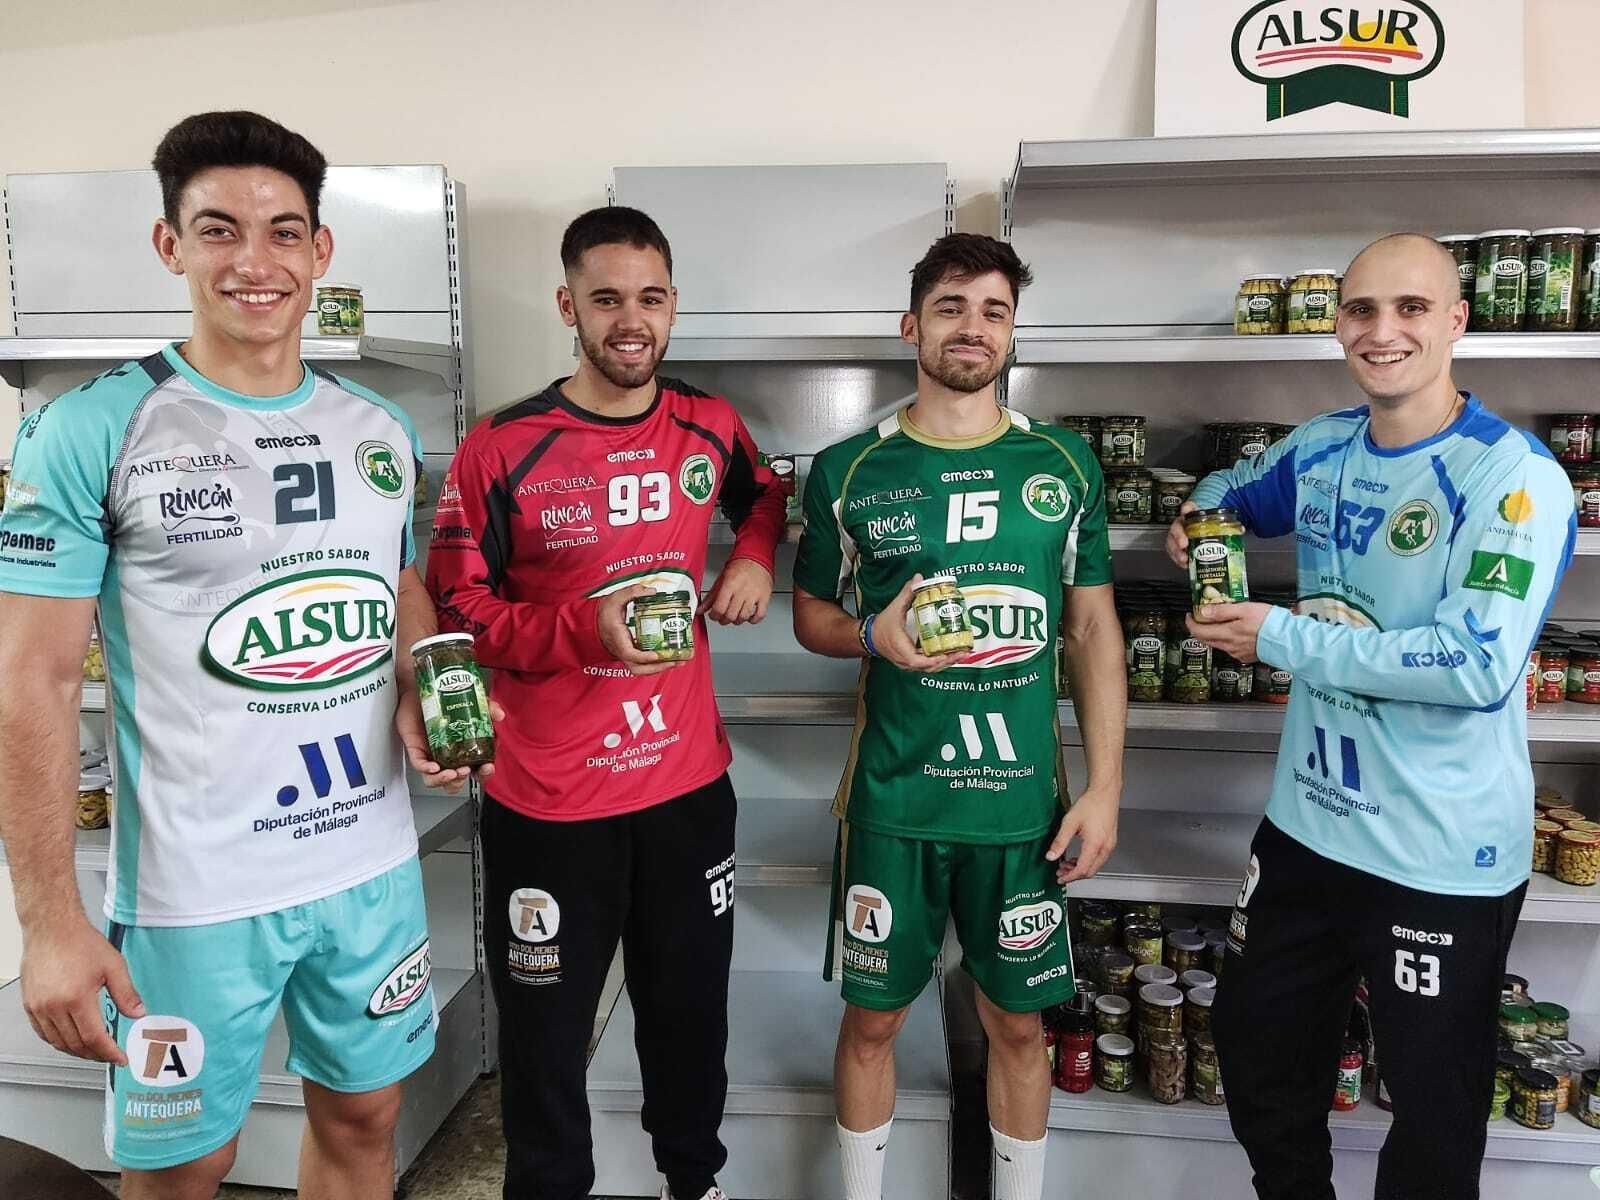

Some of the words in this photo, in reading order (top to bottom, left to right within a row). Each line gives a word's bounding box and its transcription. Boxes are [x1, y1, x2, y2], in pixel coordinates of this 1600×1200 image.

[1257, 7, 1419, 51] ALSUR
[1495, 262, 1522, 271] ALSUR
[255, 435, 309, 449] emec
[607, 450, 647, 463] emec
[941, 469, 982, 482] emec
[273, 460, 336, 525] 21
[607, 472, 670, 527] 93
[946, 490, 1000, 544] 15
[166, 527, 243, 545] FERTILIDAD
[1335, 499, 1386, 556] 63
[546, 534, 599, 551] FERTILIDAD
[873, 543, 922, 559] FERTILIDAD
[1197, 546, 1226, 558] ALSUR
[261, 552, 325, 574] NUESTRO
[327, 548, 370, 562] SABOR
[606, 554, 653, 574] NUESTRO
[656, 551, 685, 561] SABOR
[988, 561, 1025, 575] SABOR
[967, 605, 1047, 641] SUR
[233, 599, 395, 668] ALSUR
[439, 673, 472, 689] ALSUR
[583, 666, 634, 678] CONSERV
[920, 676, 976, 692] CONSERVA
[978, 682, 991, 692] LO
[993, 672, 1040, 690] NATURAL
[247, 700, 320, 714] CONSERVA
[323, 697, 337, 710] LO
[340, 676, 388, 705] NATURAL
[641, 730, 680, 753] Provincial
[611, 762, 626, 773] de
[628, 753, 662, 769] Málaga
[923, 764, 981, 779] Diputación
[983, 764, 1035, 778] Provincial
[950, 778, 965, 789] de
[966, 777, 1008, 792] Málaga
[1305, 790, 1317, 803] de
[1328, 787, 1381, 816] Provincial
[253, 807, 330, 833] Diputación
[332, 786, 386, 816] Provincial
[293, 825, 312, 840] de
[314, 812, 359, 838] Málaga
[998, 907, 1057, 938] ALSUR
[1392, 924, 1440, 944] emec
[508, 949, 560, 966] ANTEQUERA
[1026, 968, 1060, 987] emec
[1395, 949, 1440, 997] 63
[124, 1098, 203, 1119] ANTEQUERA
